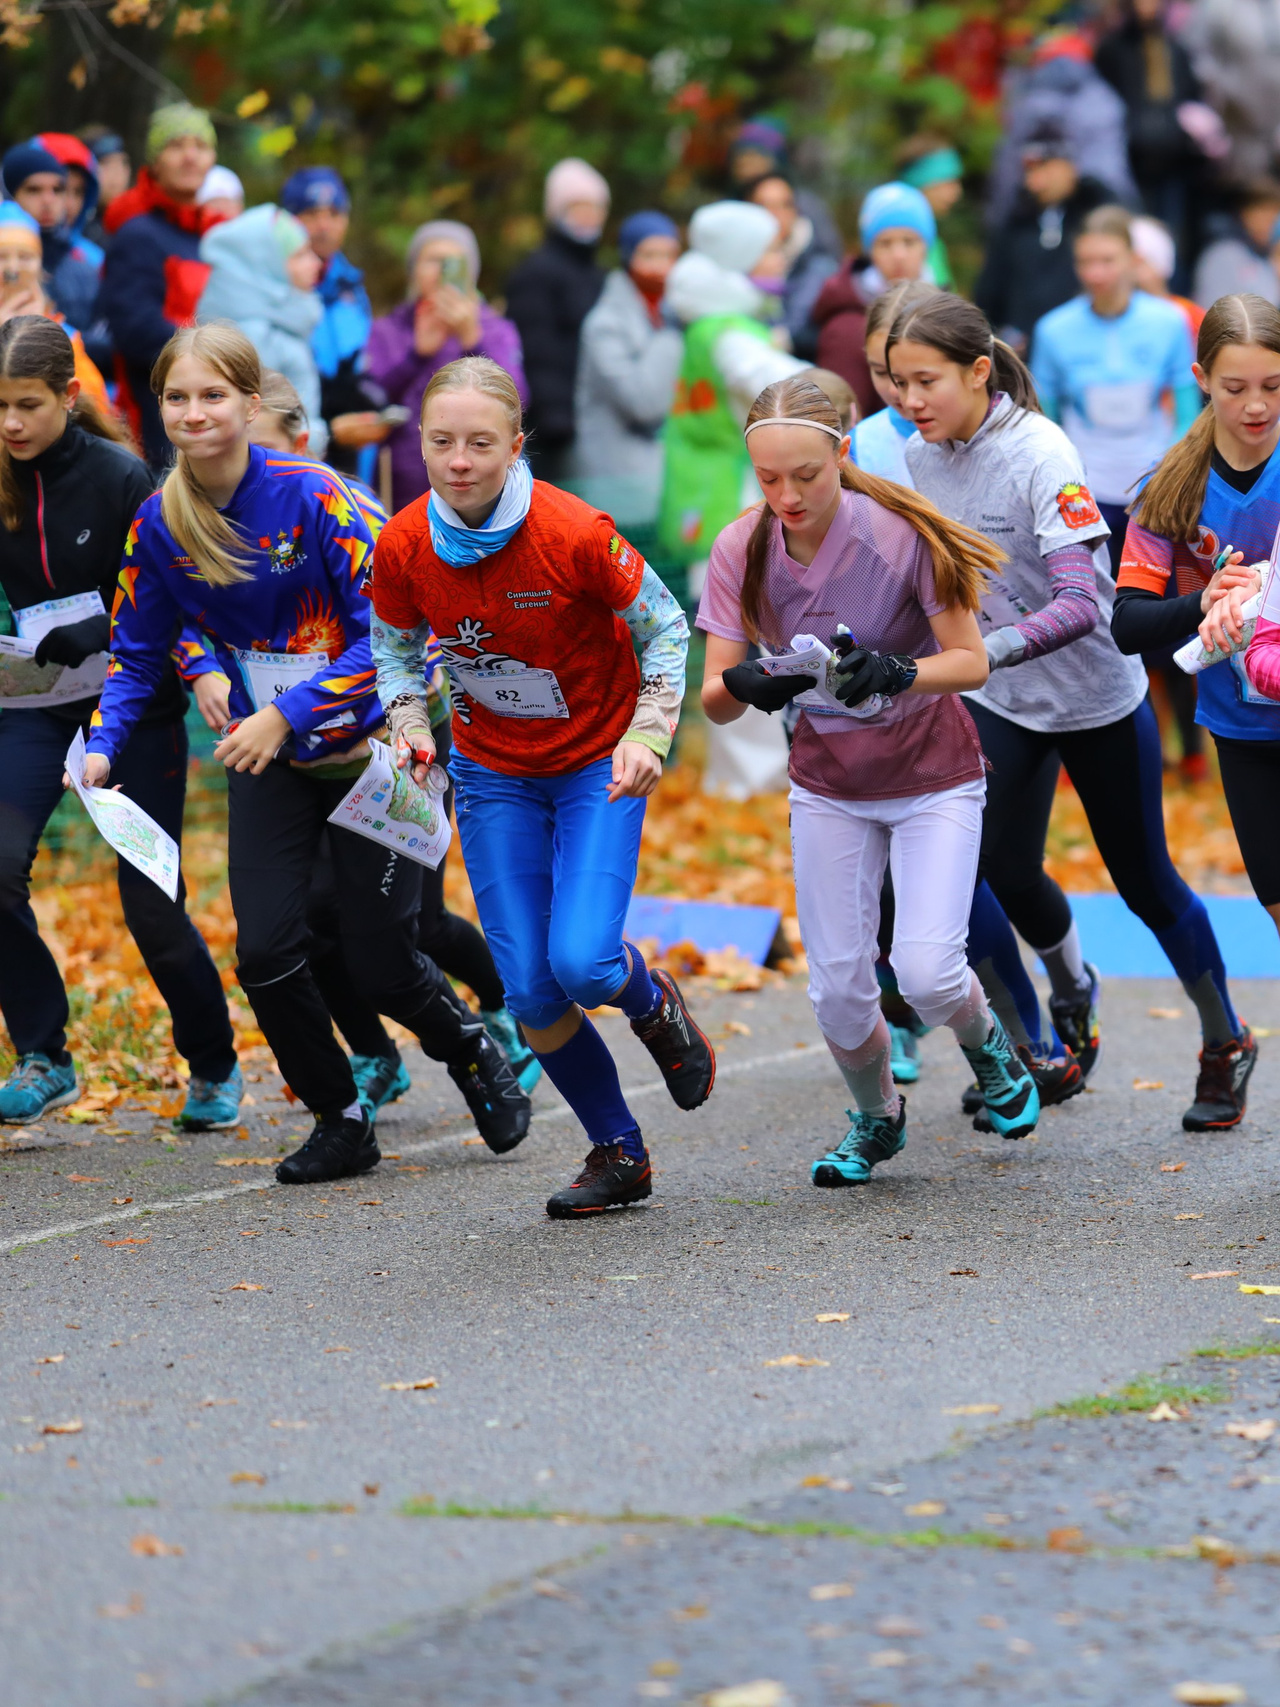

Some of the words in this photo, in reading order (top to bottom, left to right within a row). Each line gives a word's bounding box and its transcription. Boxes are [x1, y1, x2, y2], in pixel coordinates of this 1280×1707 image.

[506, 589, 552, 599] Синицына
[513, 600, 550, 609] Евгения
[495, 689, 522, 702] 82
